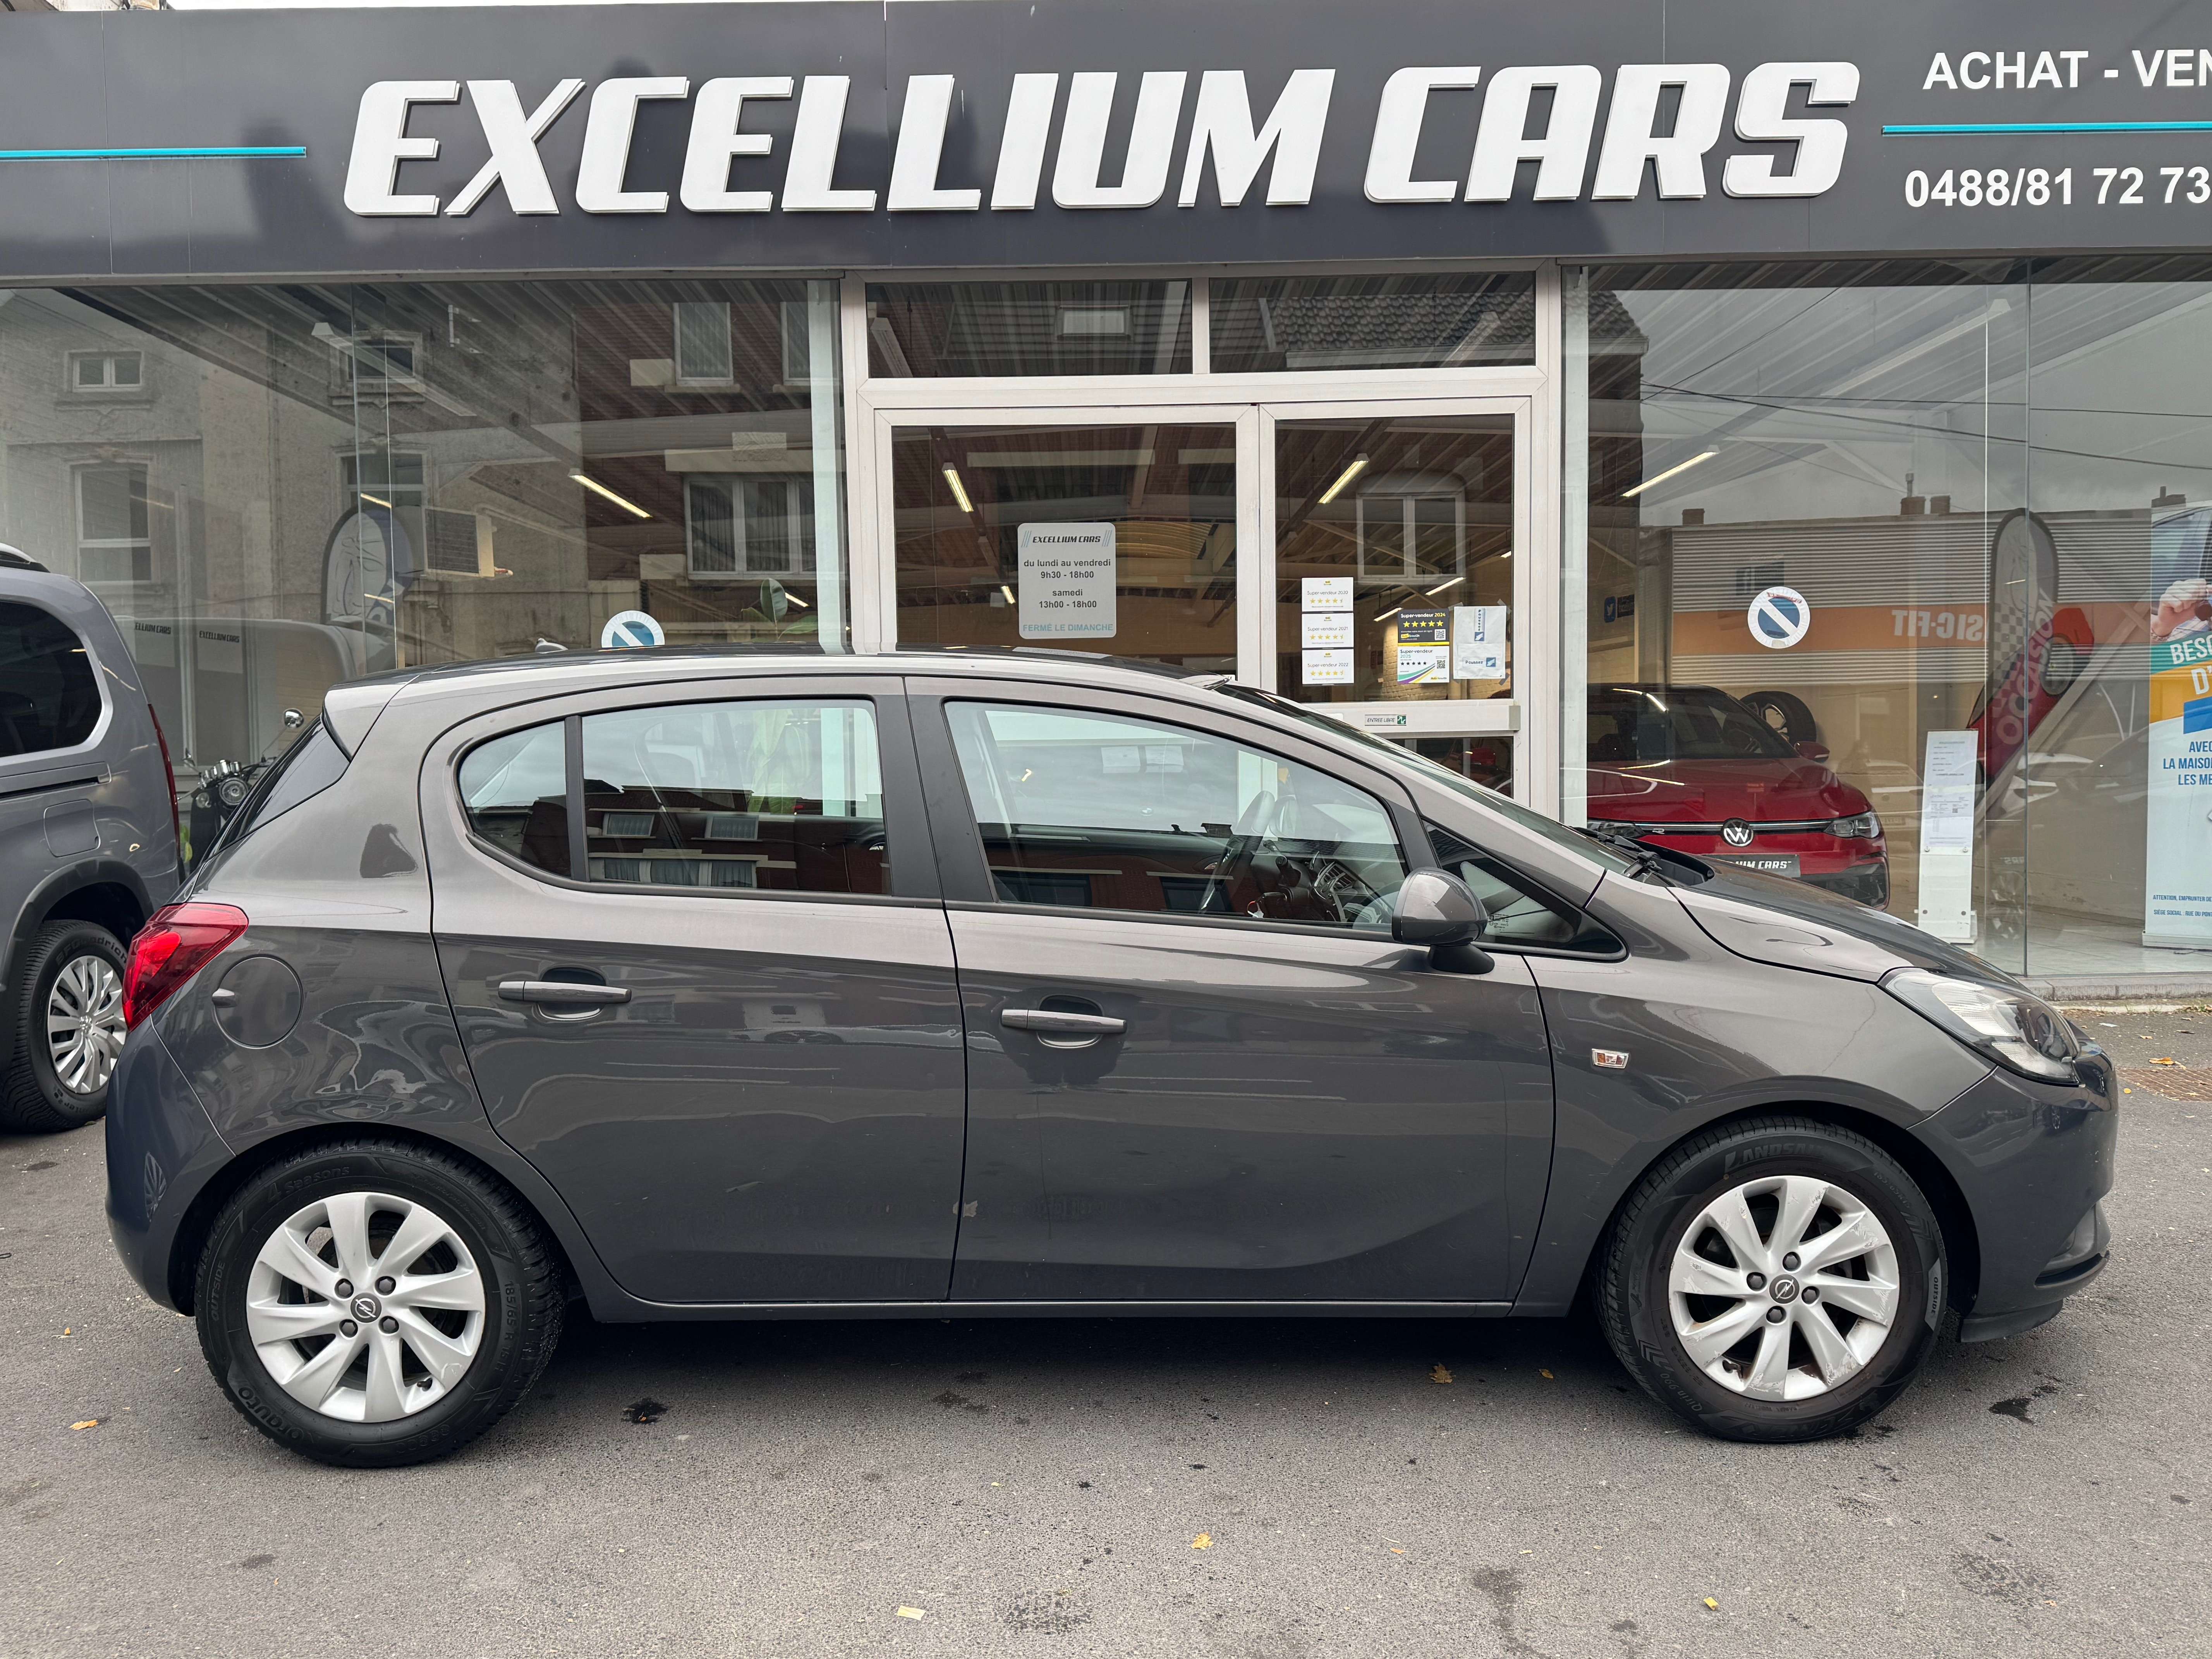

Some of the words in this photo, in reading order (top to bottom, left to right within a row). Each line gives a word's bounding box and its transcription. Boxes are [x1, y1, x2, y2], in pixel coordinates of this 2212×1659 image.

[1922, 51, 2088, 89] ACHAT
[2104, 69, 2119, 78] -
[343, 69, 1335, 215] EXCELLIUM
[1364, 62, 1860, 203] CARS
[1905, 168, 2071, 208] 0488/81
[2093, 167, 2144, 204] 72
[2160, 167, 2211, 204] 73
[2189, 741, 2212, 752] AVEC
[2163, 758, 2176, 769] LA
[2178, 757, 2212, 769] MAISO
[2178, 774, 2196, 785] LES
[1758, 861, 1788, 869] CARS
[239, 1381, 314, 1446] orauto
